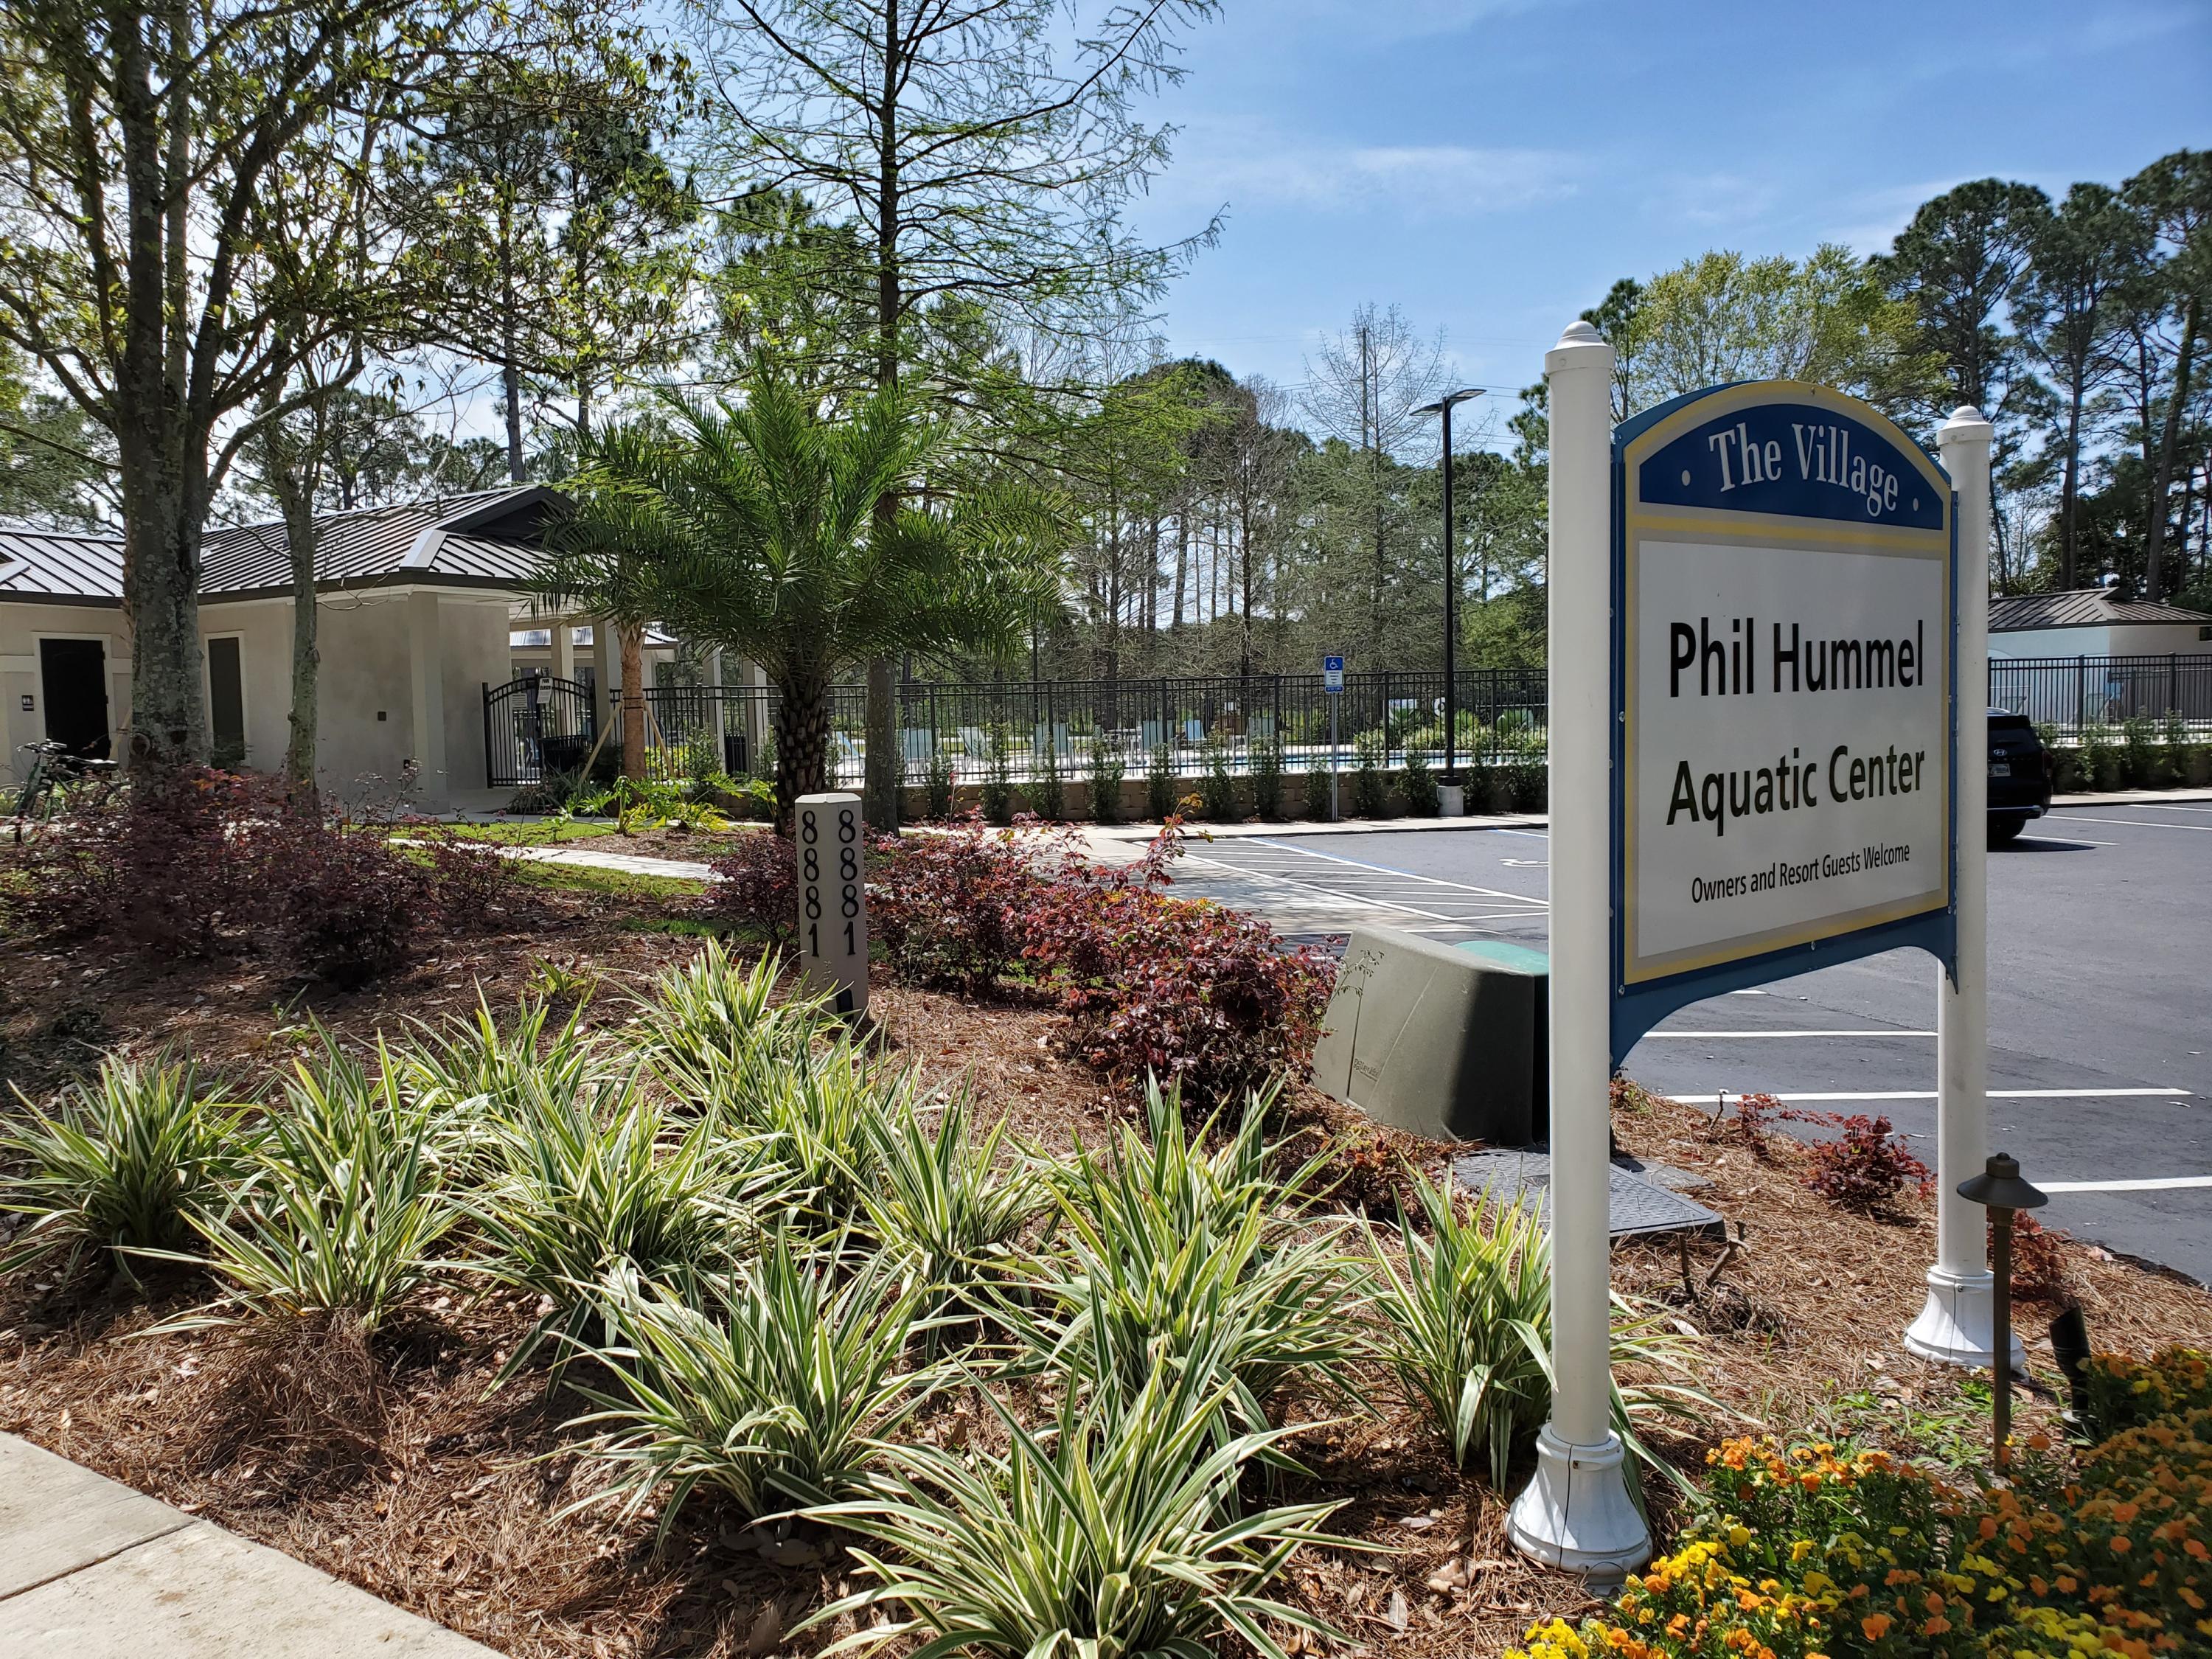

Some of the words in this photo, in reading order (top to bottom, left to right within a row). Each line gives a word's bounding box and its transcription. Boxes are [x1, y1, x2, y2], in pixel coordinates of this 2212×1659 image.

[1708, 422, 1782, 493] The
[1791, 423, 1899, 517] Village
[1670, 616, 1754, 698] Phil
[1773, 619, 1923, 693] Hummel
[1666, 746, 1818, 837] Aquatic
[1829, 744, 1925, 804] Center
[801, 810, 821, 958] 8881
[838, 809, 860, 956] 8881
[1691, 877, 1747, 904] Owners
[1750, 862, 1775, 893] and
[1779, 858, 1819, 887] Resort
[1822, 851, 1861, 878] Guests
[1863, 842, 1910, 870] Welcome
